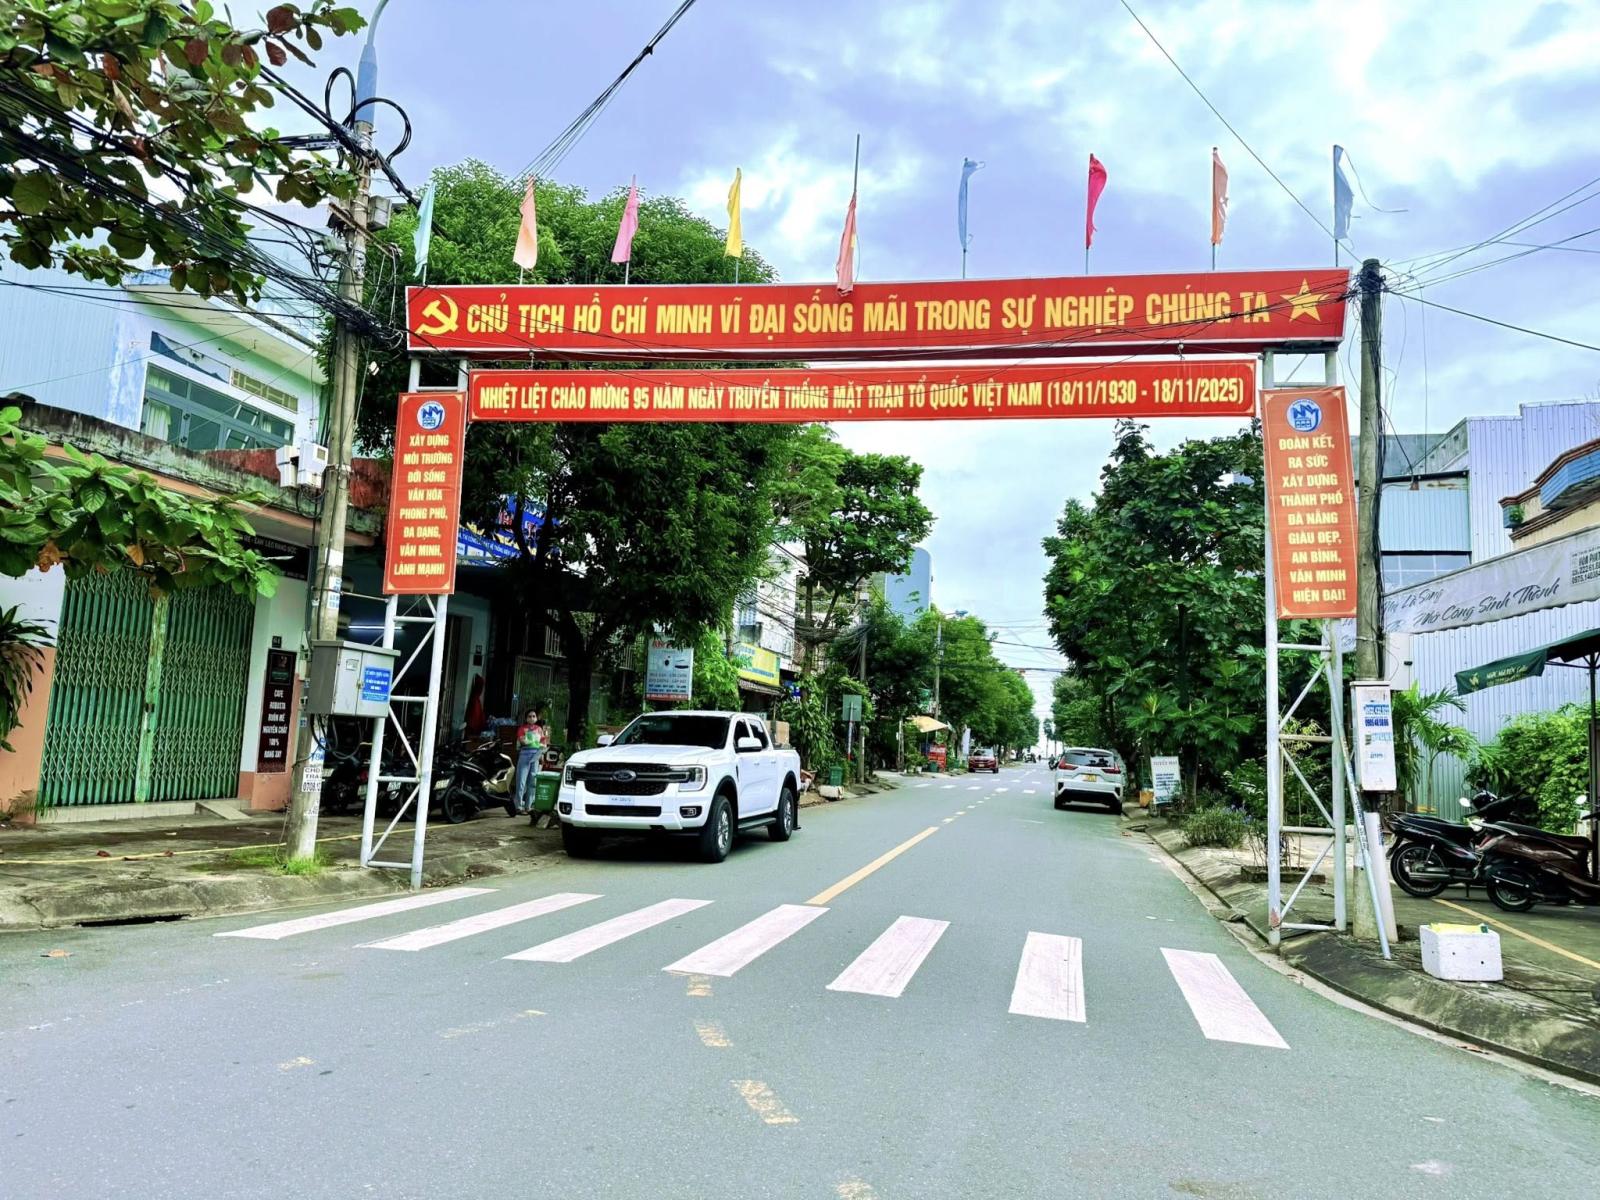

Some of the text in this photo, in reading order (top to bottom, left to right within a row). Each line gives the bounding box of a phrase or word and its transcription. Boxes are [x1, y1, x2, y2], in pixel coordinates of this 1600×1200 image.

[467, 284, 1270, 340] CHỦ TỊCH HỒ CHÍ MINH VĨ ĐẠI SỐNG MÃI TRONG SỰ NGHIỆP CHÚNG TA
[480, 382, 518, 413] NHIỆT
[521, 382, 547, 413] LIỆT
[551, 383, 586, 409] CHÀO
[590, 381, 629, 409] MỪNG
[634, 387, 650, 409] 95
[653, 382, 684, 409] NĂM
[688, 382, 723, 409] NGÀY
[728, 379, 780, 409] TRUYỀN
[784, 378, 829, 408] THỐNG
[833, 381, 863, 413] MẶT
[867, 380, 904, 413] TRẬN
[908, 375, 926, 408] TỔ
[930, 375, 968, 409] QUỐC
[973, 378, 1004, 412] VIỆT
[1008, 382, 1042, 406] NAM
[1047, 379, 1137, 407] (18/11/1930
[1153, 377, 1244, 405] 18/11/2025)
[1279, 436, 1310, 450] ĐOÀN
[1287, 453, 1329, 469] RA SỨC
[1282, 473, 1338, 489] XÂY DỰNG
[1280, 488, 1344, 507] THÀNH PHỐ
[399, 507, 428, 520] PHONG
[1287, 508, 1338, 526] ĐÀ NẴNG
[1288, 530, 1315, 545] GIÀU
[1292, 551, 1308, 564] AN
[1289, 569, 1347, 583] VĂN MINH
[1293, 587, 1320, 604] HIỆN
